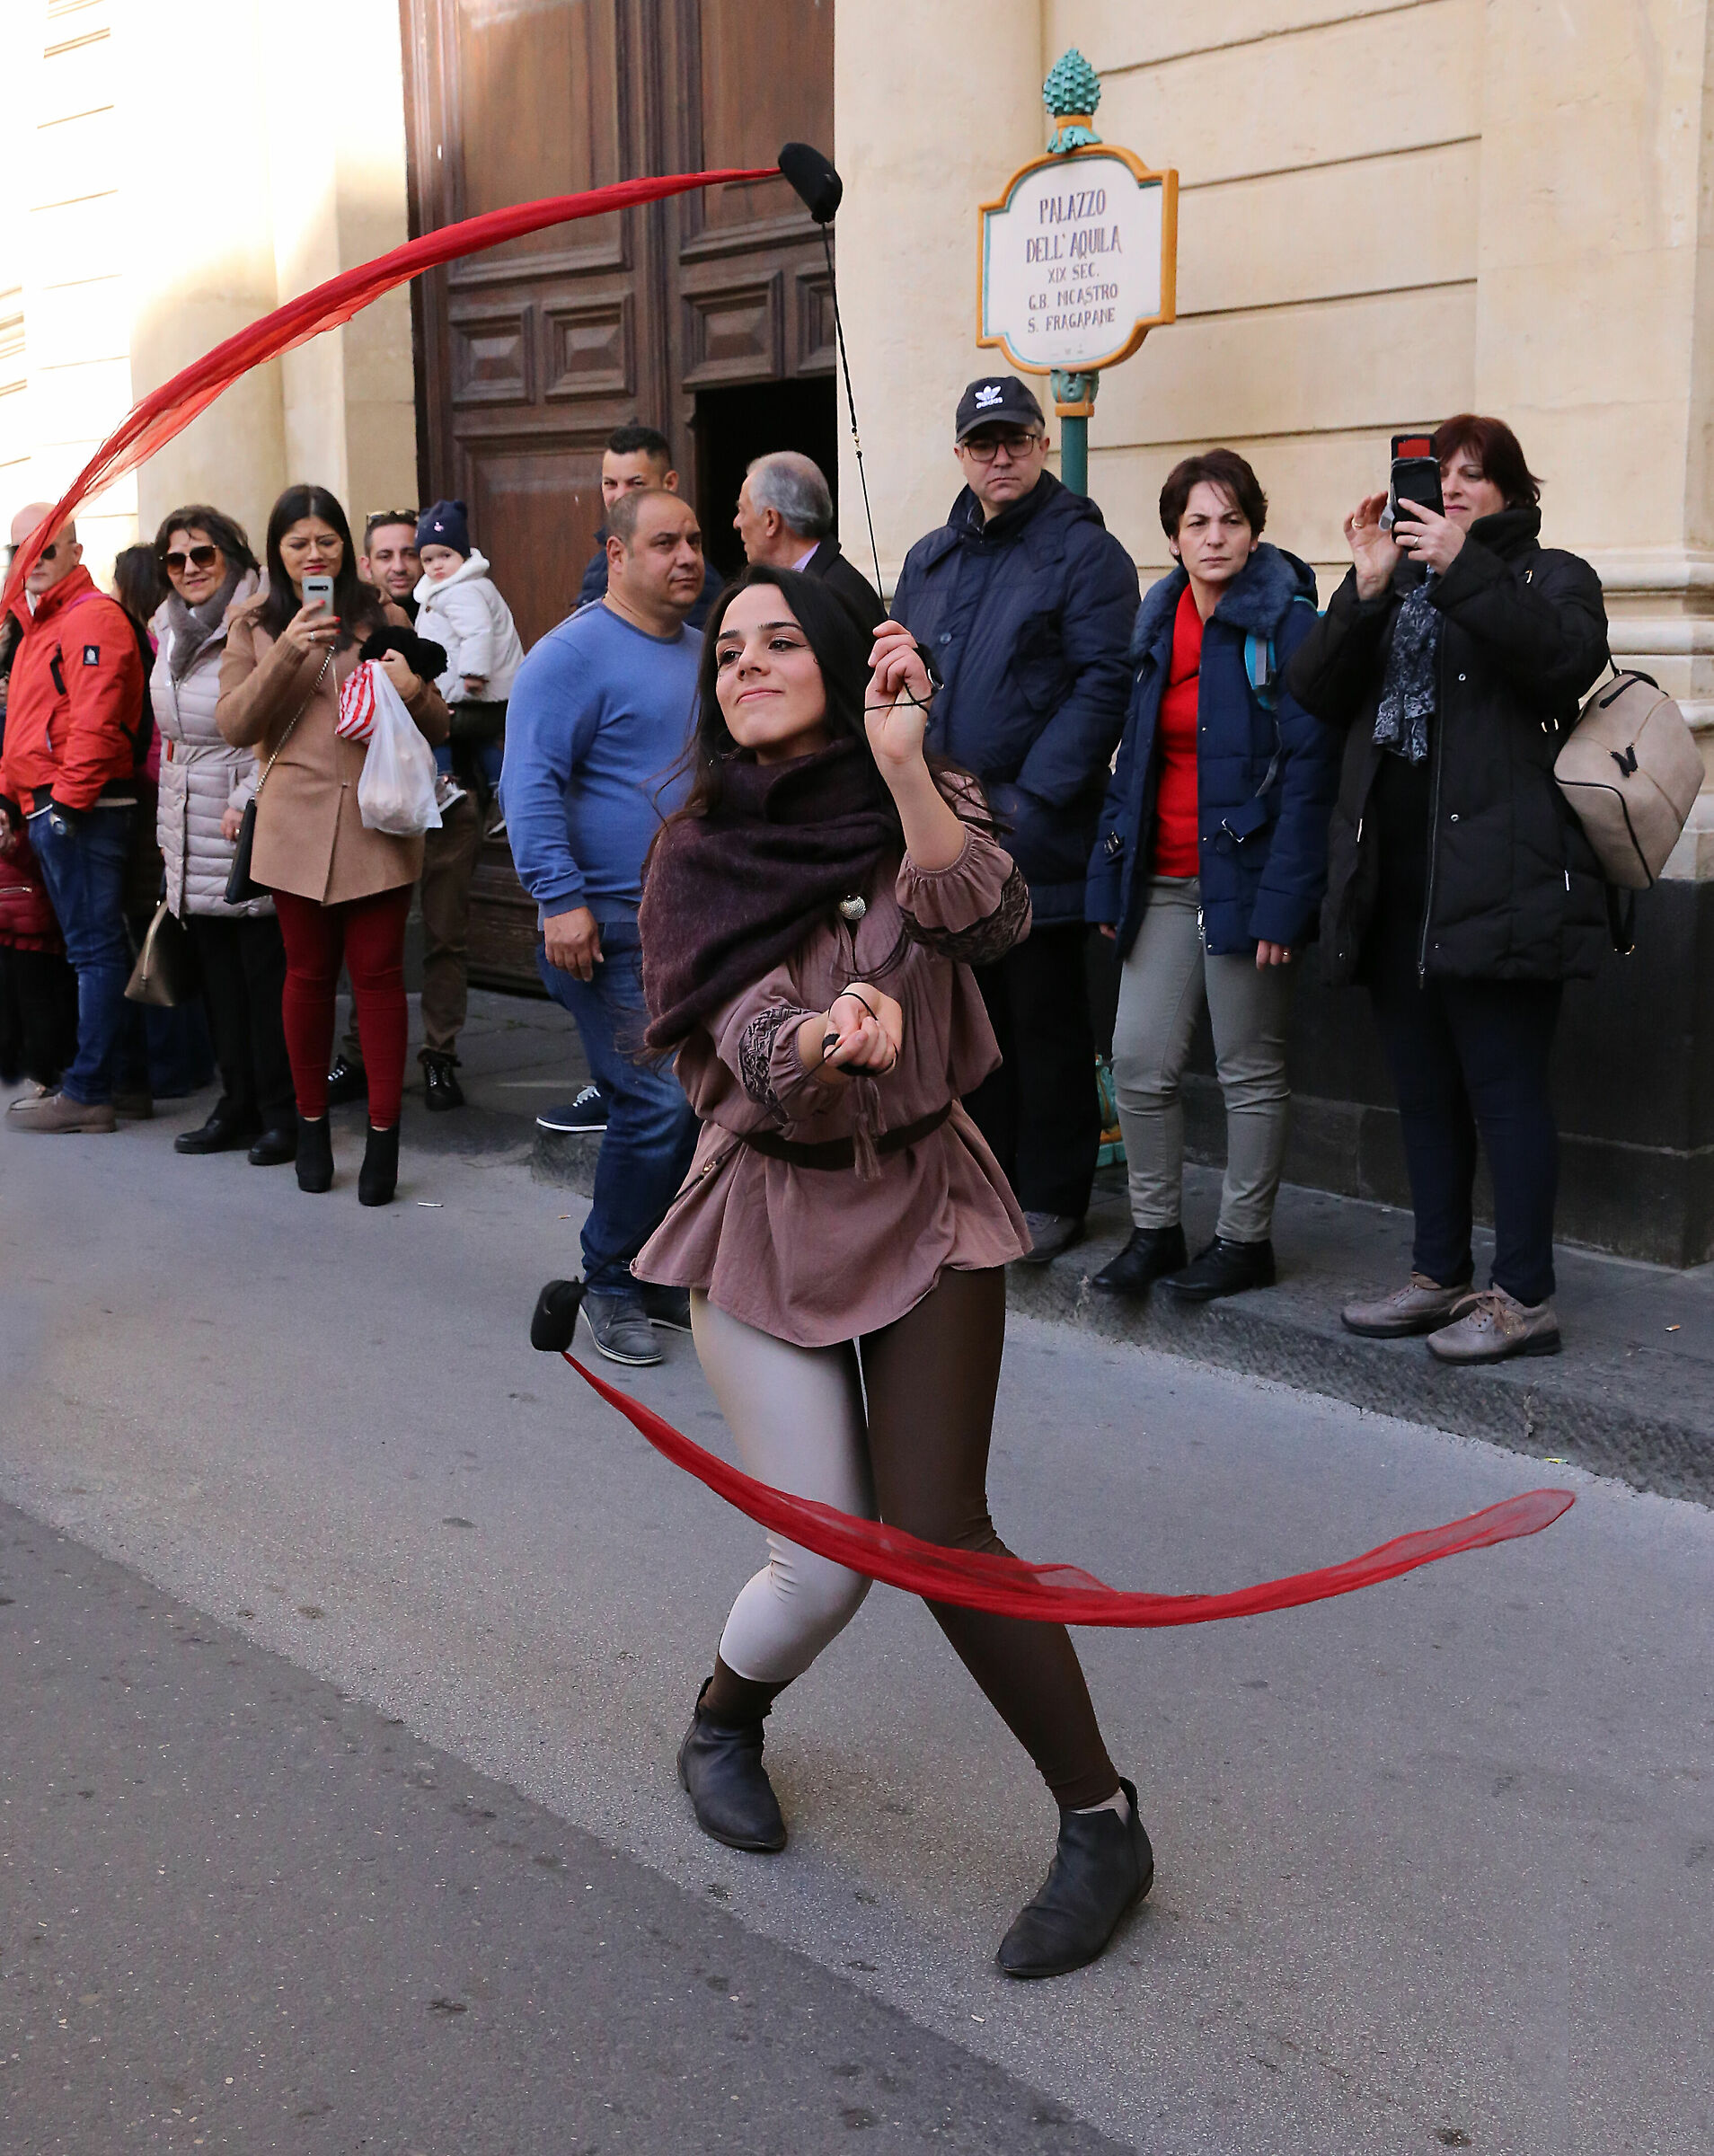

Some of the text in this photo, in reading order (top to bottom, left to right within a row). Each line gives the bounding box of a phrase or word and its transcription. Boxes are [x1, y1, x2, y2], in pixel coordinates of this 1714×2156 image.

[1038, 188, 1106, 225] PALAZZO
[1047, 261, 1100, 284] XIX SEC.
[1056, 283, 1118, 307] NICASTRO
[1028, 307, 1116, 333] S. FRAGAPANE
[976, 396, 1003, 409] adidas
